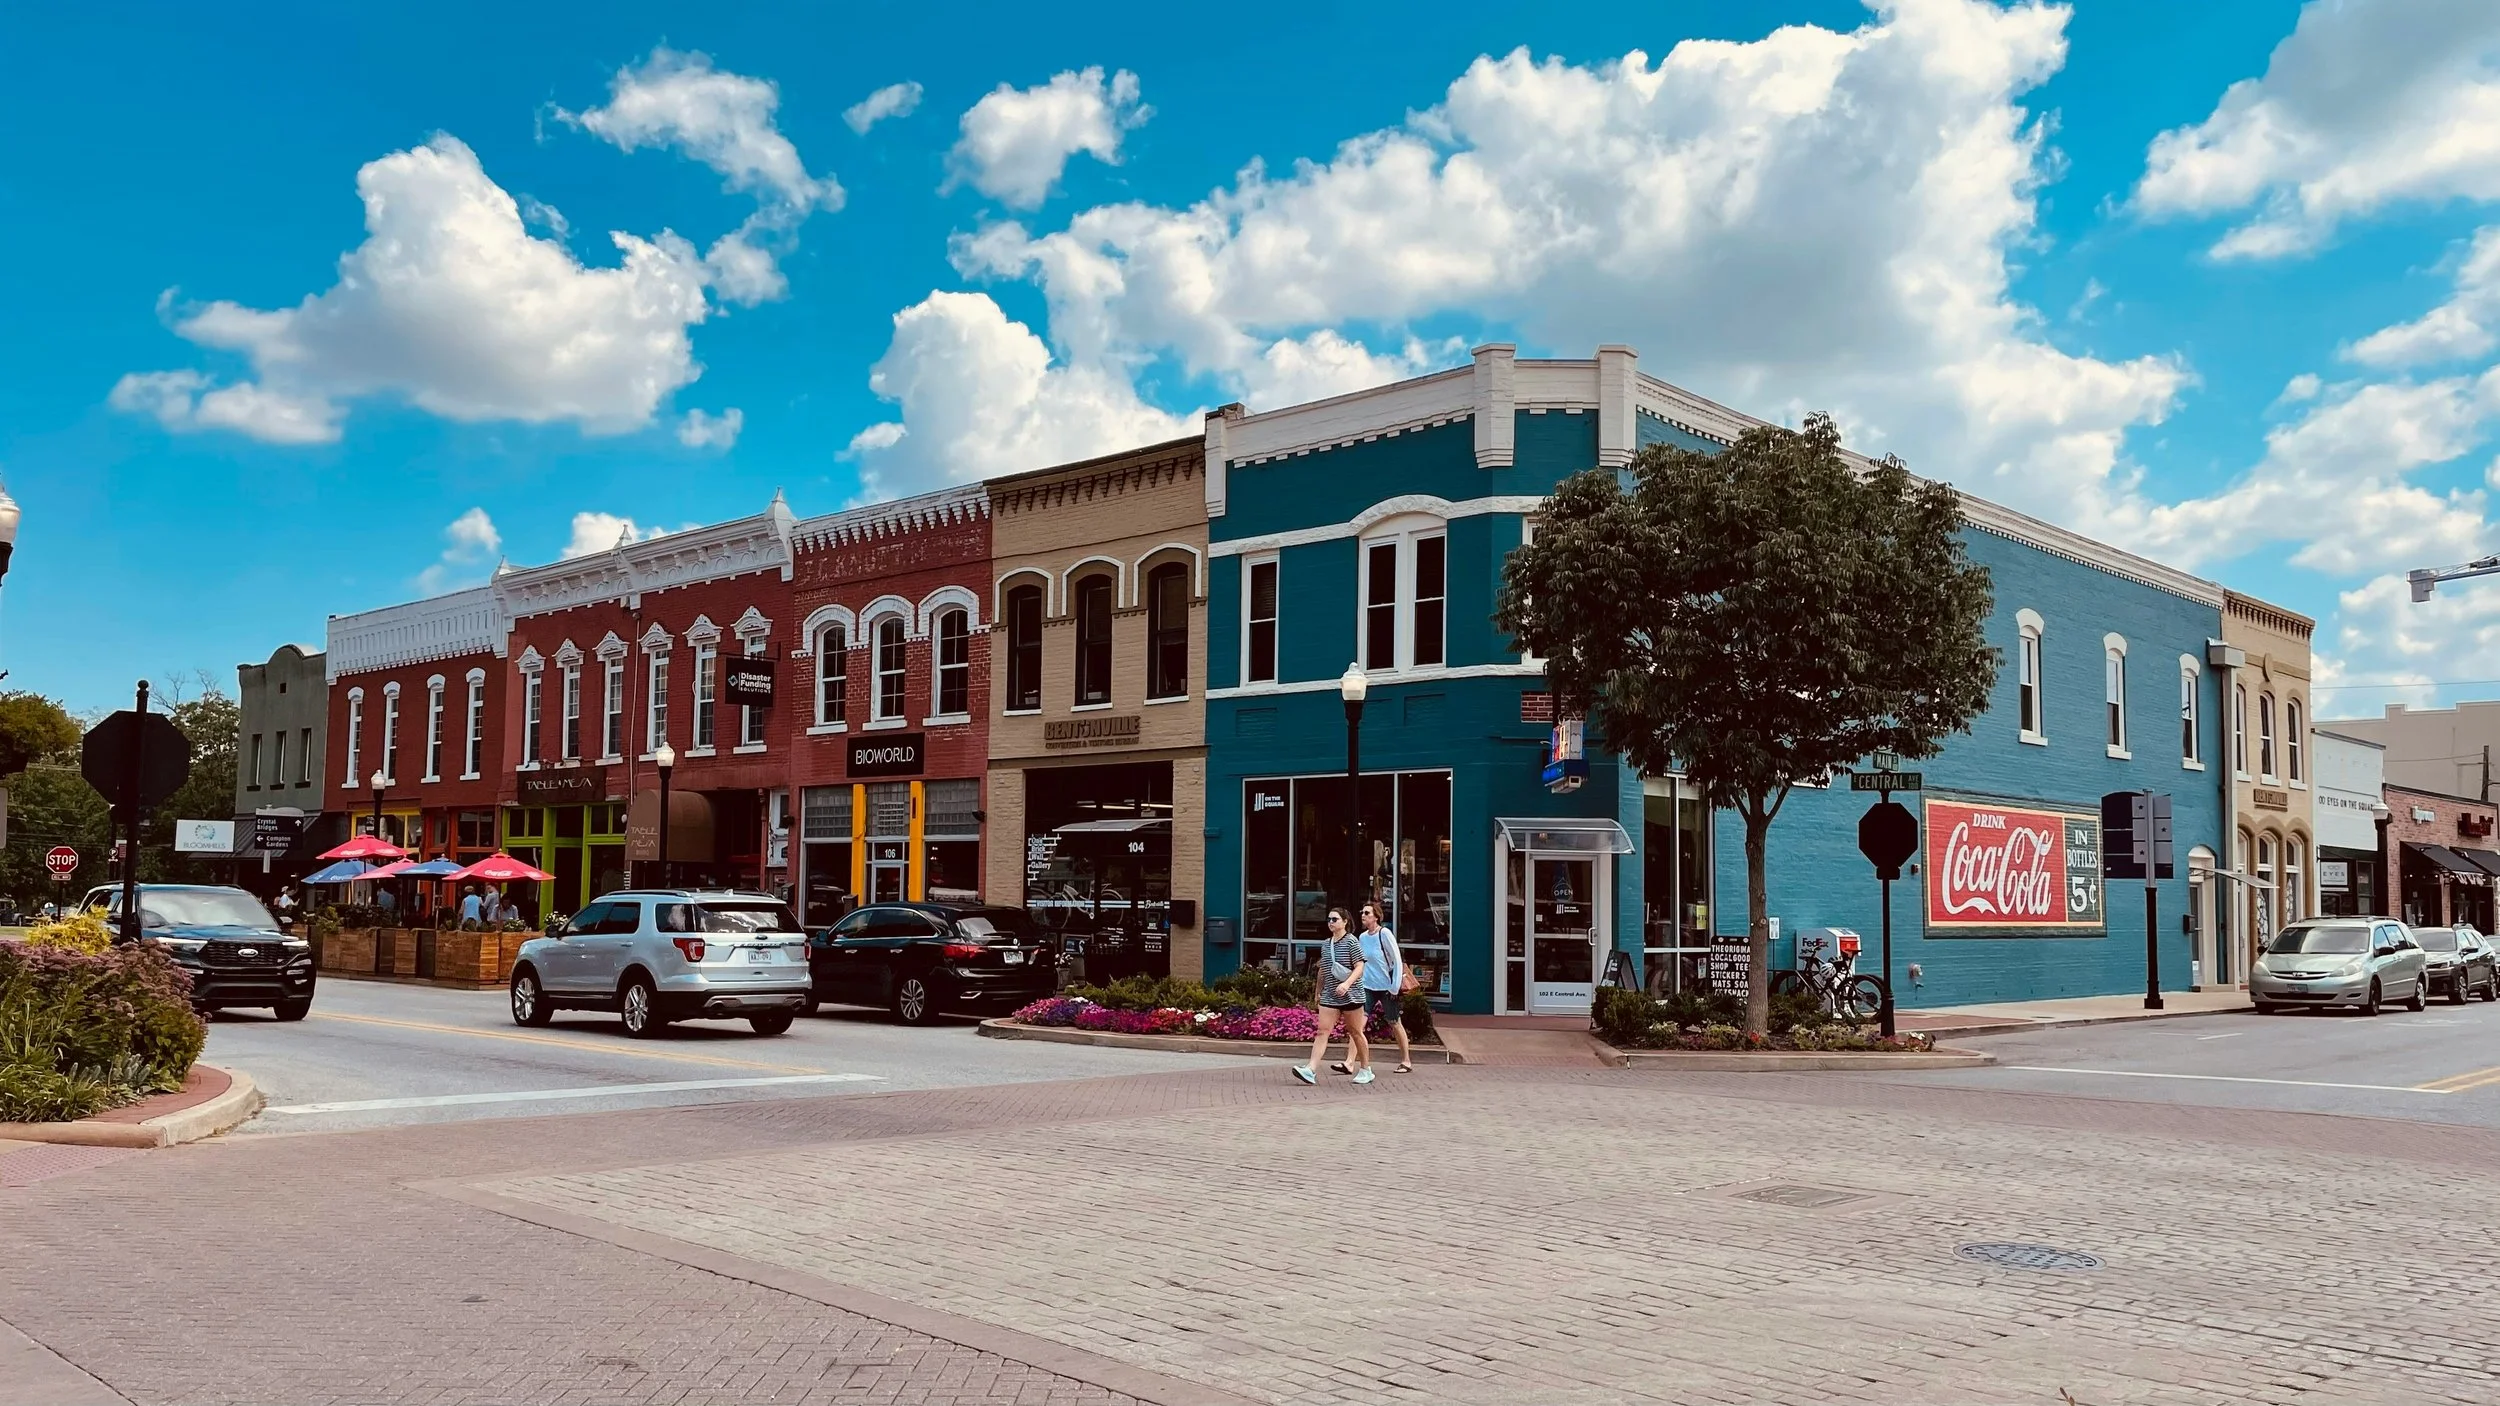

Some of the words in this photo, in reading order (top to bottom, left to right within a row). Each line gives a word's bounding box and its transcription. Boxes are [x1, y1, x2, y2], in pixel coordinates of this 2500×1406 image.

[741, 672, 771, 682] Disaster
[741, 680, 771, 690] Funding
[855, 746, 915, 765] BIOWORLD
[1876, 754, 1892, 769] MAIN
[1858, 775, 1905, 789] CENTRAL
[2327, 796, 2339, 807] EYES
[2340, 799, 2348, 808] ON
[2348, 800, 2357, 810] THE
[1972, 812, 2006, 829] DRINK
[2074, 829, 2088, 846] IN
[1128, 842, 1144, 852] 104
[885, 848, 896, 859] 106
[2067, 849, 2097, 868] BOTTLES
[48, 855, 76, 865] STOP
[1030, 861, 1052, 870] Gallery
[1941, 822, 2055, 916] Coca-Cola
[1802, 937, 1829, 948] FedEx
[1710, 962, 1729, 971] SHOP
[1735, 963, 1750, 971] TEE
[1712, 980, 1731, 988] HATS
